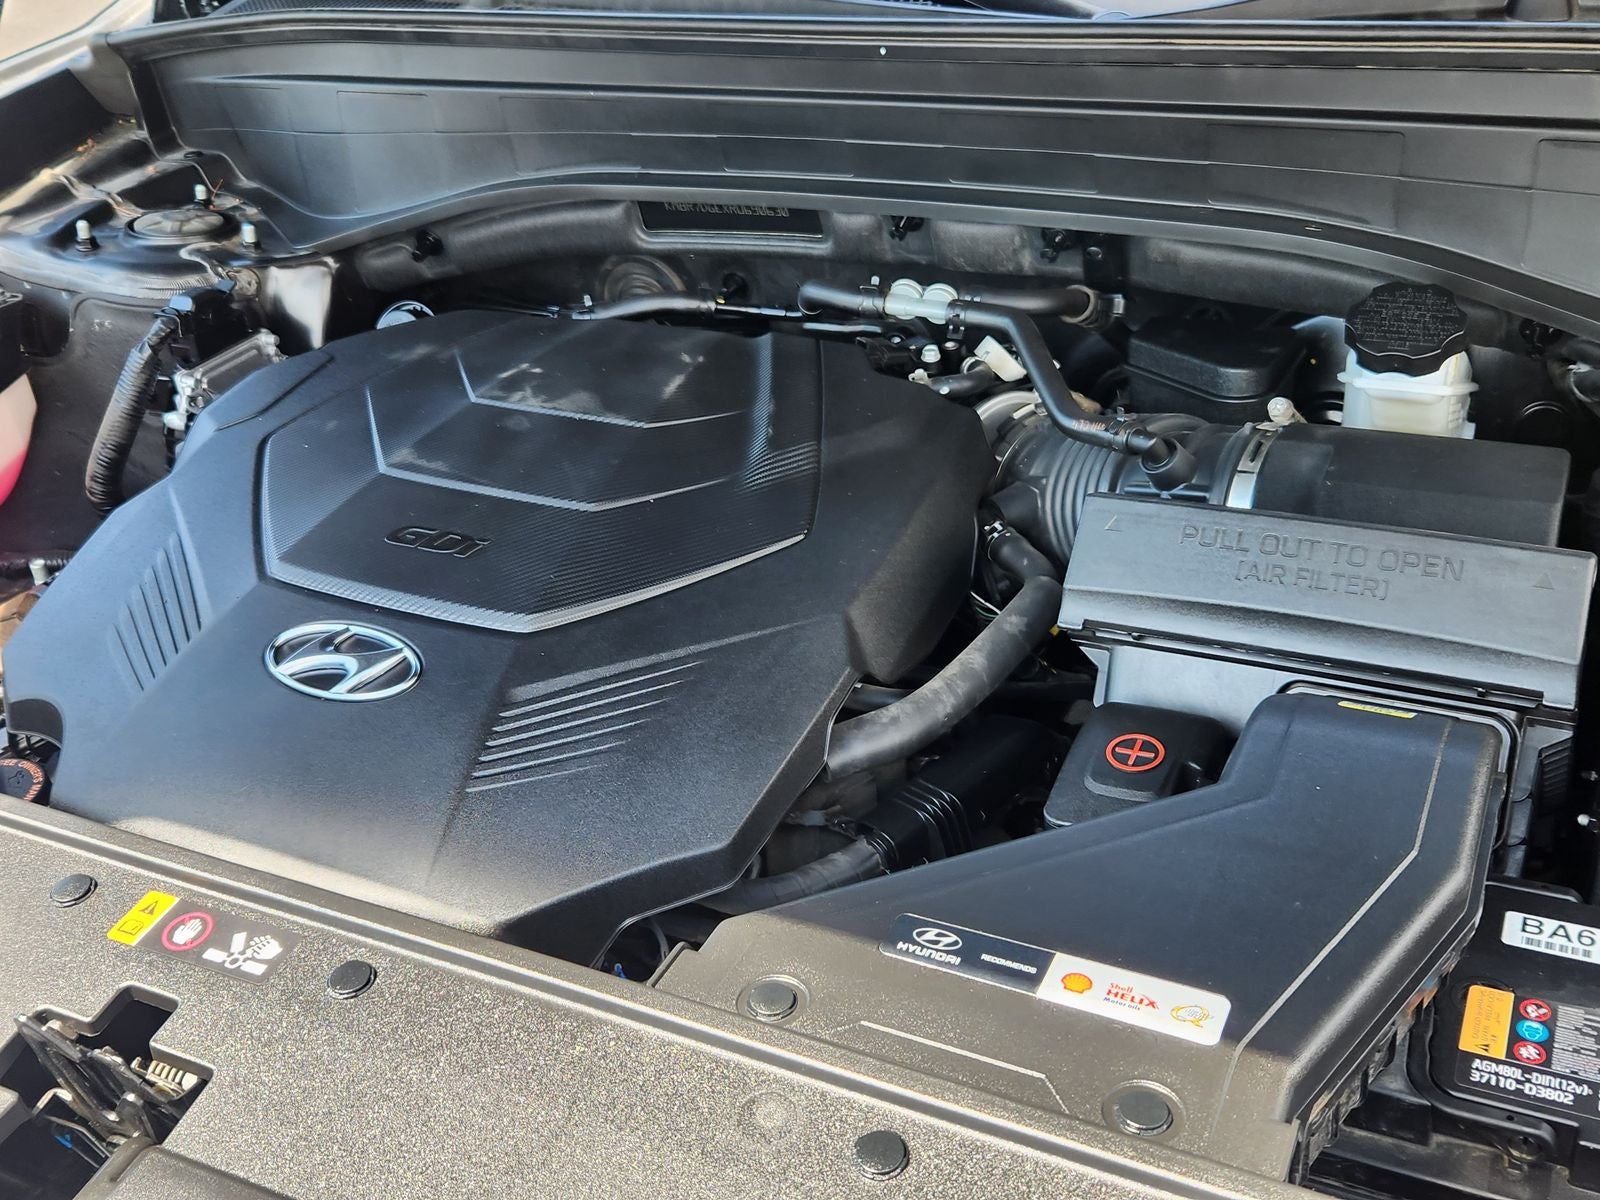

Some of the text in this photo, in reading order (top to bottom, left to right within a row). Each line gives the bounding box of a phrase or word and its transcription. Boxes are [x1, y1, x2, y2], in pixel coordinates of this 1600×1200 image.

[1180, 525, 1465, 582] PULL OUT TO OPEN
[1521, 916, 1597, 947] BA6
[896, 941, 961, 966] HYUNDAI
[981, 953, 1037, 974] RECOMMENDS
[1106, 989, 1160, 1010] HELIX
[1110, 982, 1134, 994] Shell
[1103, 996, 1127, 1008] Motor
[1469, 1069, 1575, 1105] 37110-D3802
